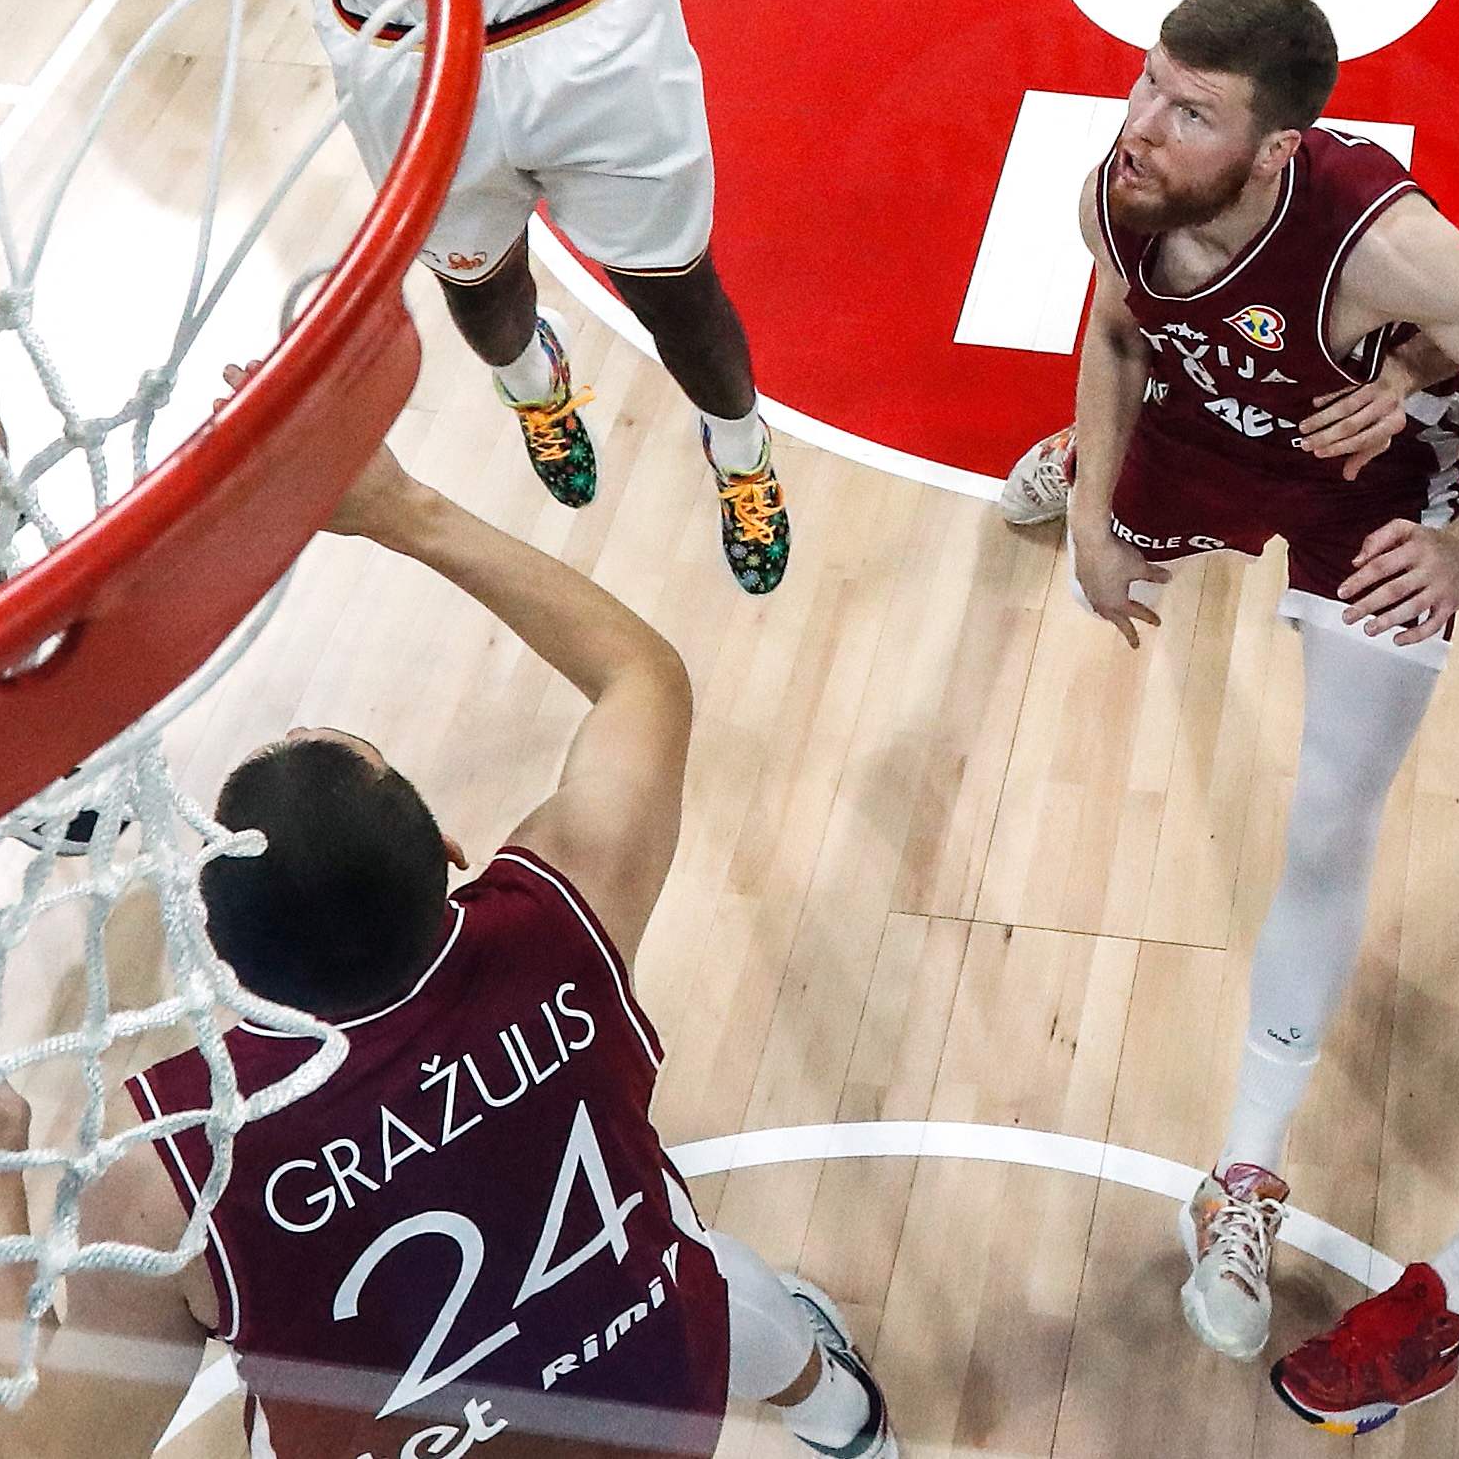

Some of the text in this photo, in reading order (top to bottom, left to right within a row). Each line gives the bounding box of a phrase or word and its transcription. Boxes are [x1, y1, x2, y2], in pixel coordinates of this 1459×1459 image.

[1110, 511, 1183, 550] IRCLE
[264, 981, 596, 1233] GRAŽULIS
[332, 1098, 643, 1420] 24
